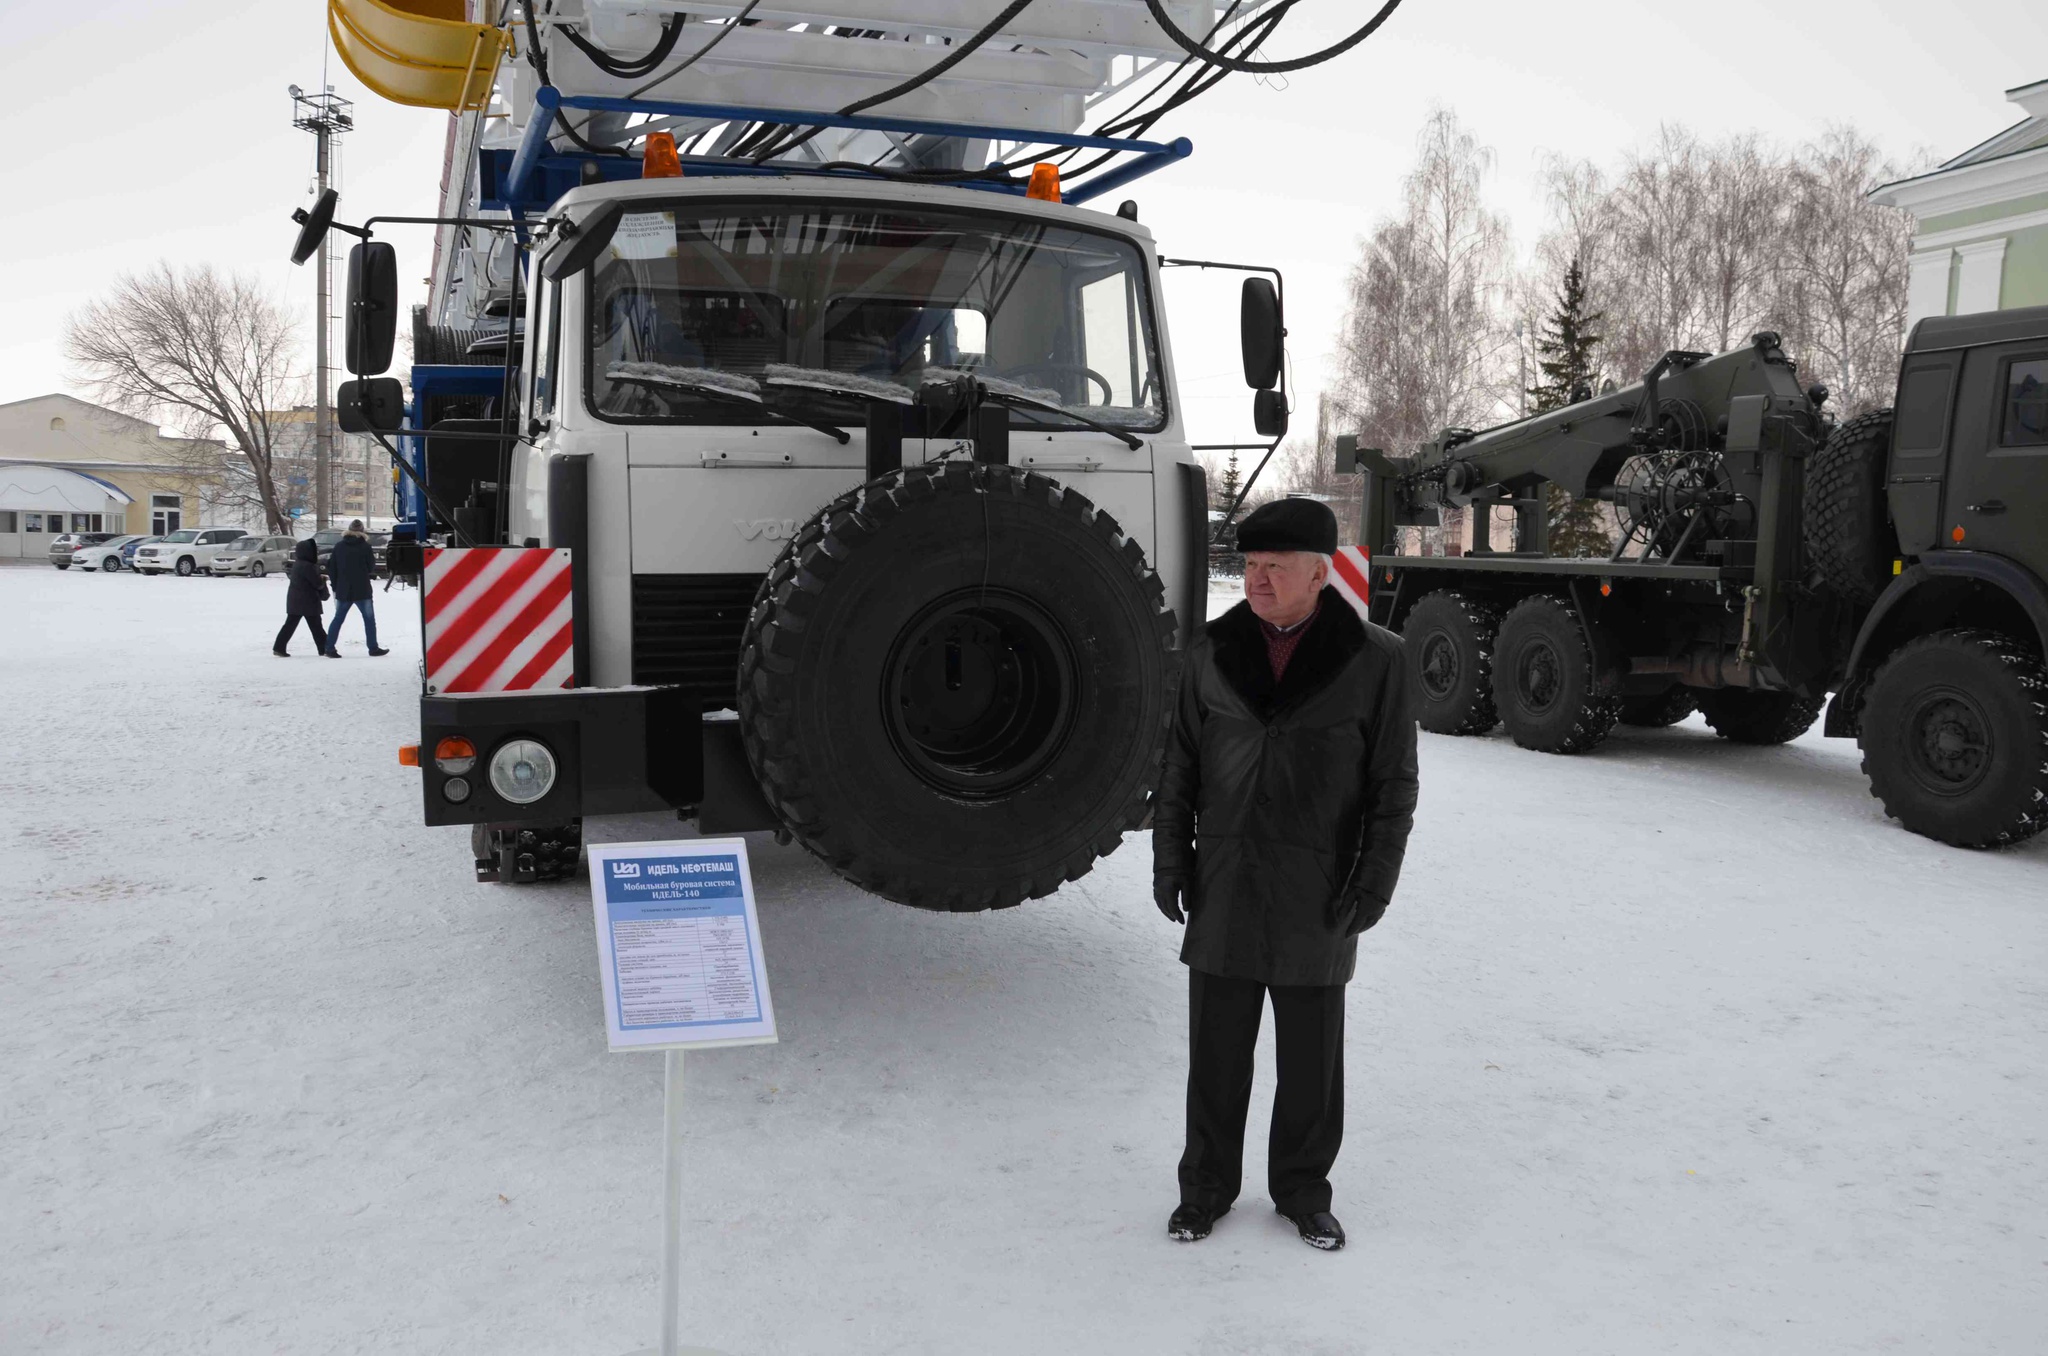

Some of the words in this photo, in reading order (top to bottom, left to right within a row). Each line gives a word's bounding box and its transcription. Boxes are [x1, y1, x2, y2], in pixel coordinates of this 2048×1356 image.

[647, 864, 680, 876] ИДЕЛЬ
[681, 862, 734, 874] НЕФТЕМАШ
[623, 881, 669, 891] Мобильная
[670, 880, 703, 891] буровая
[704, 879, 735, 888] система
[652, 890, 700, 899] ИДЕЛЬ-140
